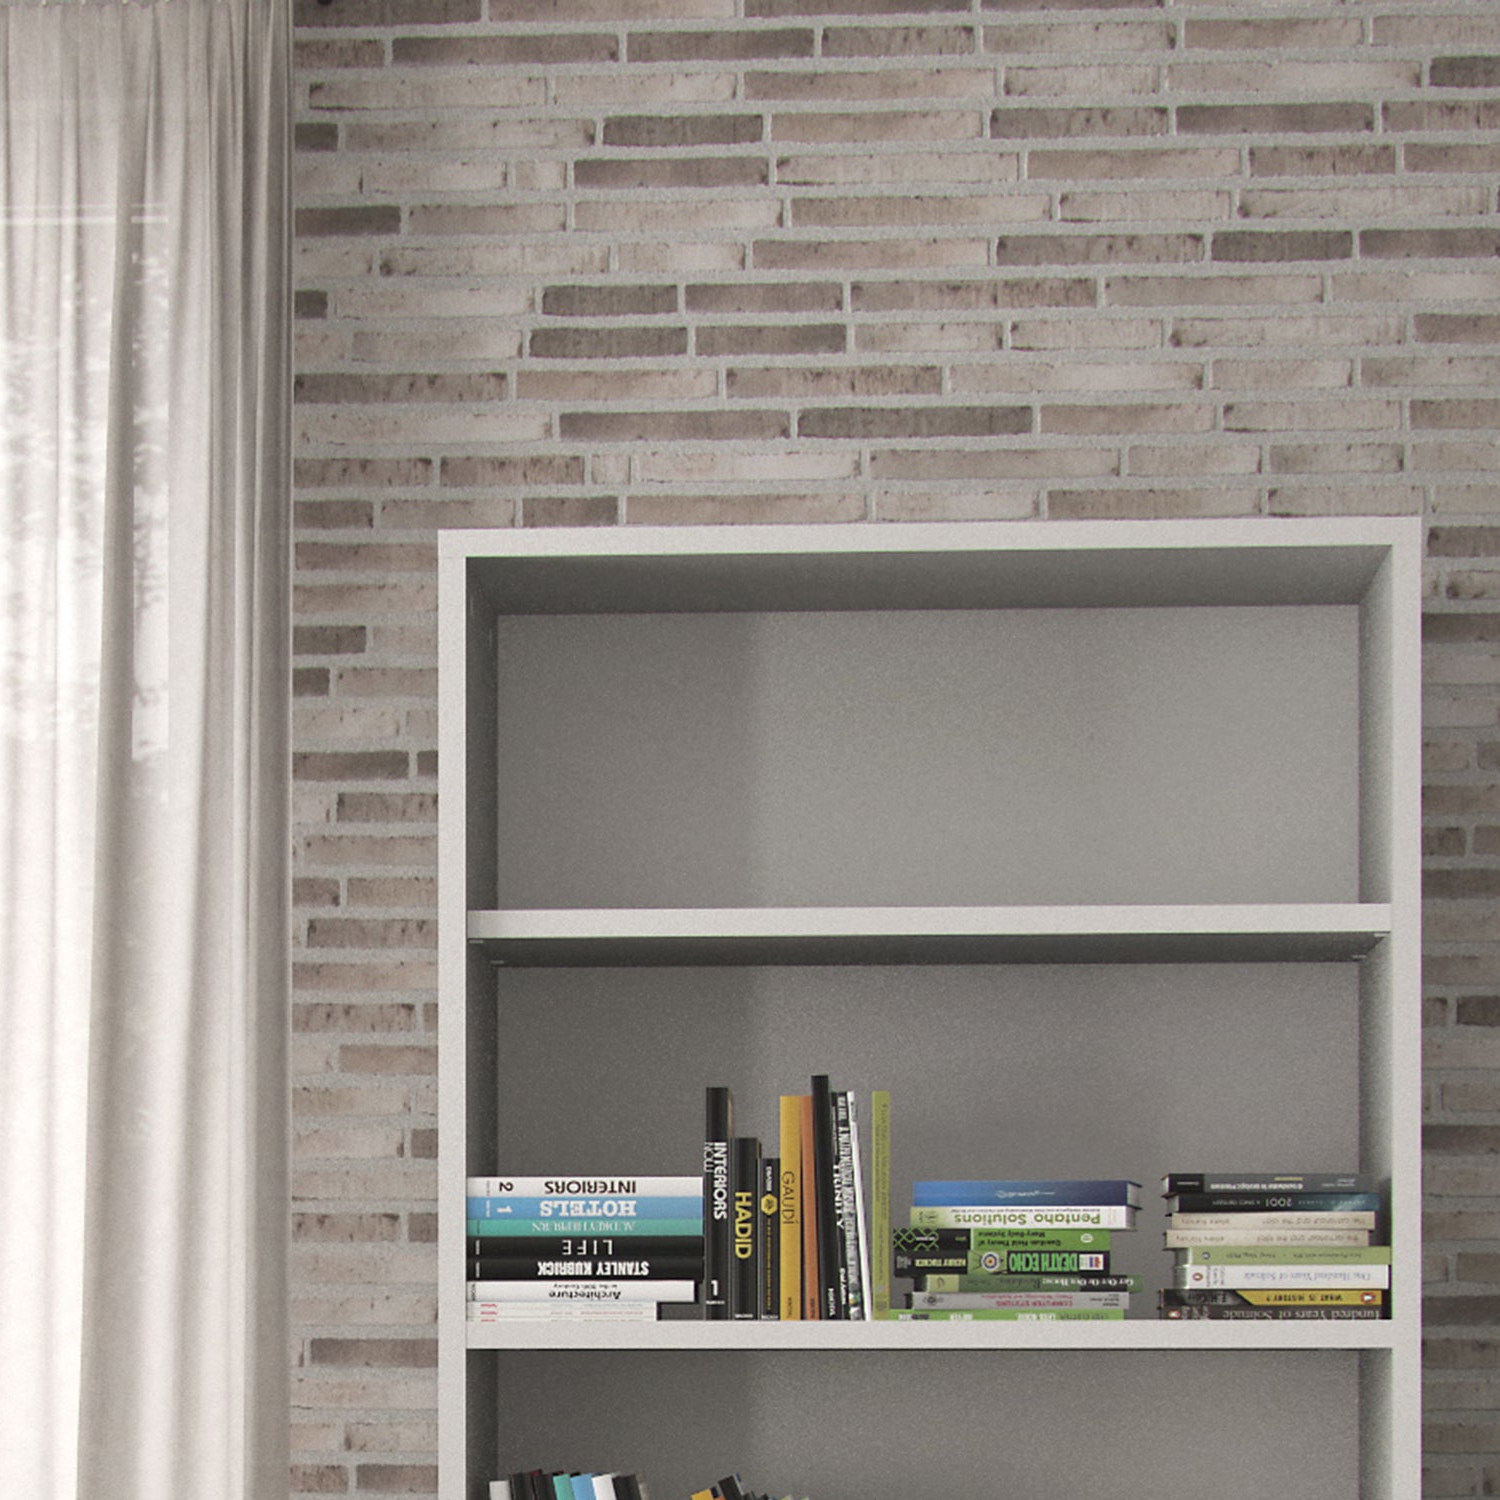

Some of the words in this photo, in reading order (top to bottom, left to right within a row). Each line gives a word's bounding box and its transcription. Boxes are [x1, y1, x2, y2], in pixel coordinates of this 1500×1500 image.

[704, 1142, 713, 1172] NOW
[499, 1181, 513, 1191] 2
[544, 1180, 635, 1193] INTERIORS
[713, 1142, 726, 1219] INTERIORS
[782, 1171, 798, 1224] GAUDÍ
[1265, 1197, 1293, 1207] 2001
[539, 1200, 636, 1216] HOTELS
[734, 1191, 751, 1258] HADID
[954, 1213, 1026, 1225] Solutions
[1033, 1213, 1100, 1224] Pentaho
[561, 1239, 612, 1254] LIFE
[537, 1261, 592, 1275] KUBRICK
[596, 1261, 649, 1275] STANLEY
[1009, 1253, 1039, 1270] ECHO
[1040, 1253, 1077, 1271] DEATH
[548, 1290, 620, 1299] Architecture
[710, 1280, 717, 1295] 1
